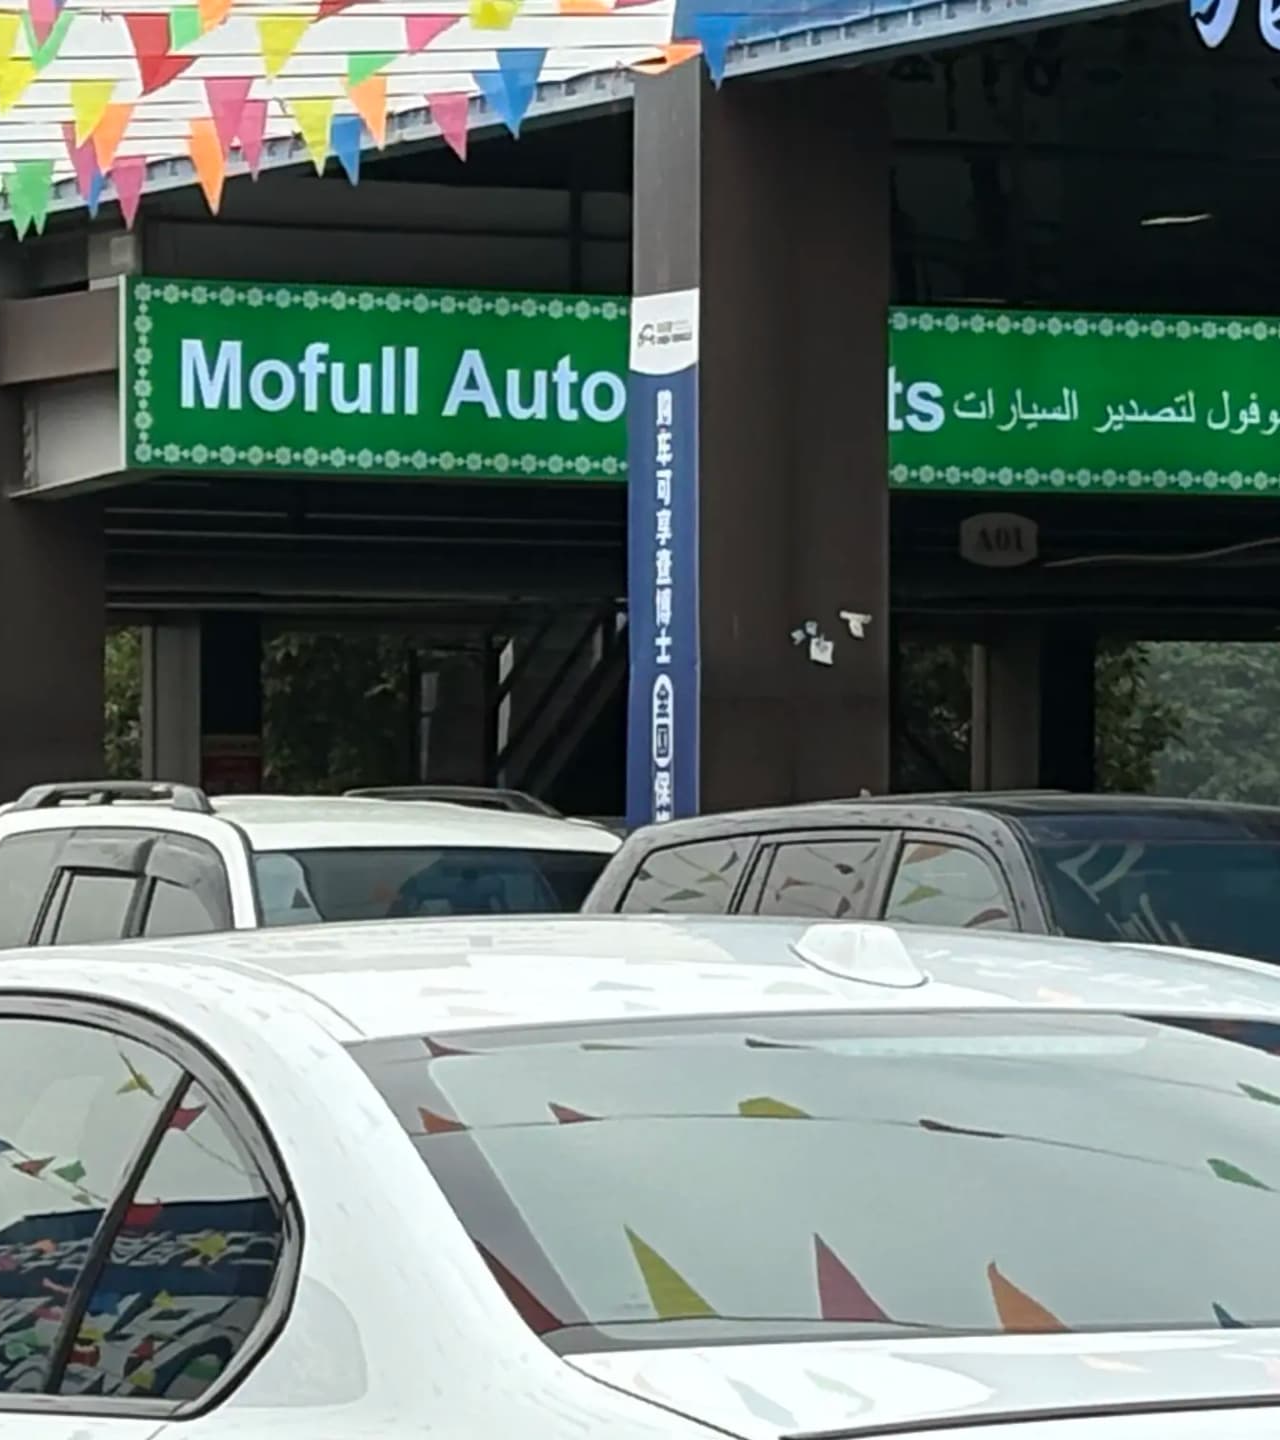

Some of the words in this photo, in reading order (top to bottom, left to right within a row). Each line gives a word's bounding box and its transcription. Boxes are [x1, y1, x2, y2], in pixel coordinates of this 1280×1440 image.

[180, 338, 420, 415] Mofull
[441, 348, 628, 423] Auto
[952, 386, 1080, 432] السيارات
[1093, 390, 1197, 433] لتصدير
